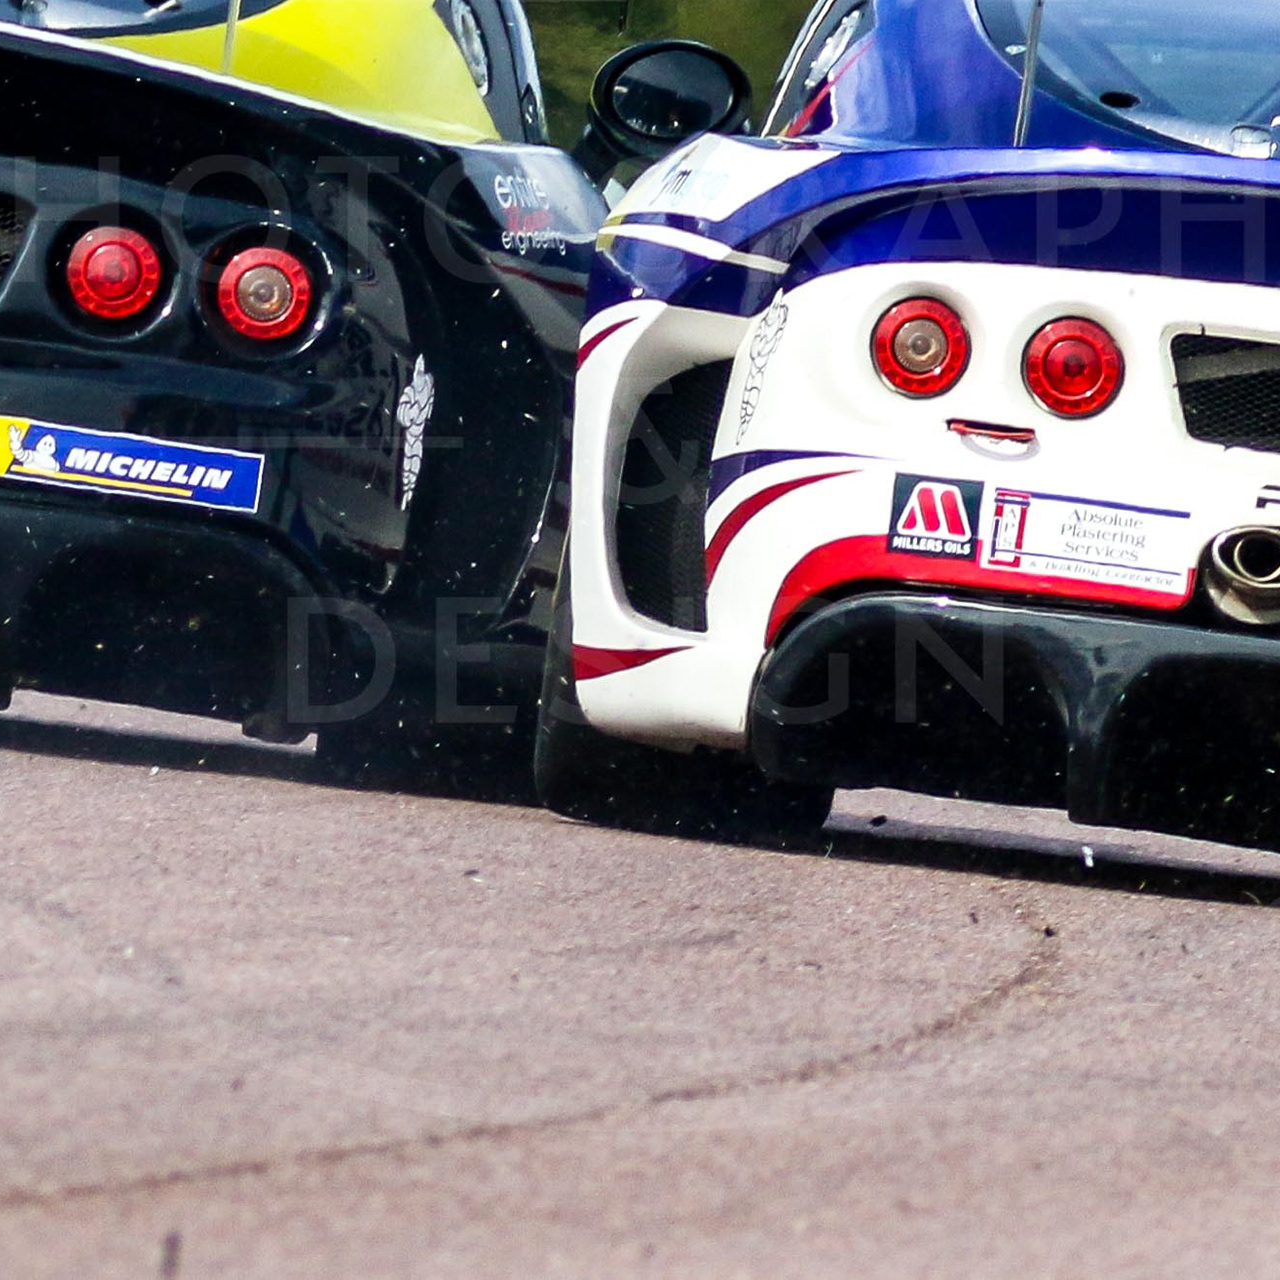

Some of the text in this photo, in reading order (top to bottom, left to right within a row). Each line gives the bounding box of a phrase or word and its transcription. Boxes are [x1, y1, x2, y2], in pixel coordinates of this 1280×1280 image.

[65, 448, 233, 490] MICHELIN
[1068, 509, 1144, 530] Absolute
[892, 536, 972, 556] MILLERS OILS
[1061, 523, 1147, 549] Plastering
[1063, 541, 1139, 562] Services
